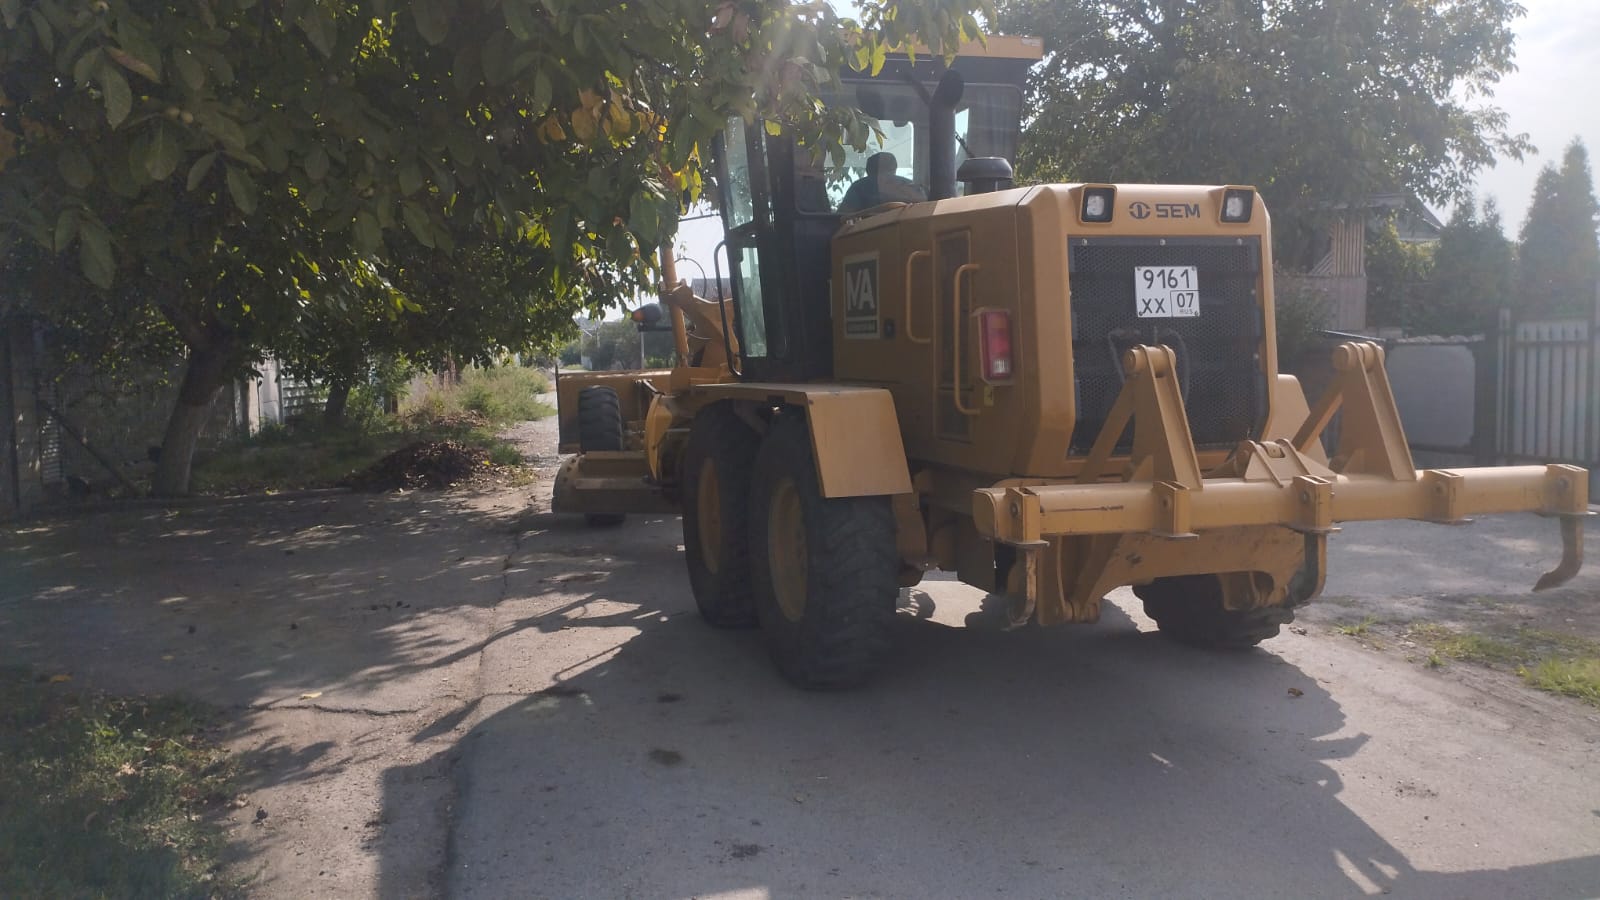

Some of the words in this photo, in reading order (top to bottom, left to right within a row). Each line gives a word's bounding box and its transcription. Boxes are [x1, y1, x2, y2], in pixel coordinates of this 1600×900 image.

[1155, 203, 1201, 218] SEM
[1142, 269, 1190, 289] 9161
[1141, 297, 1166, 314] XX
[1176, 292, 1194, 308] 07
